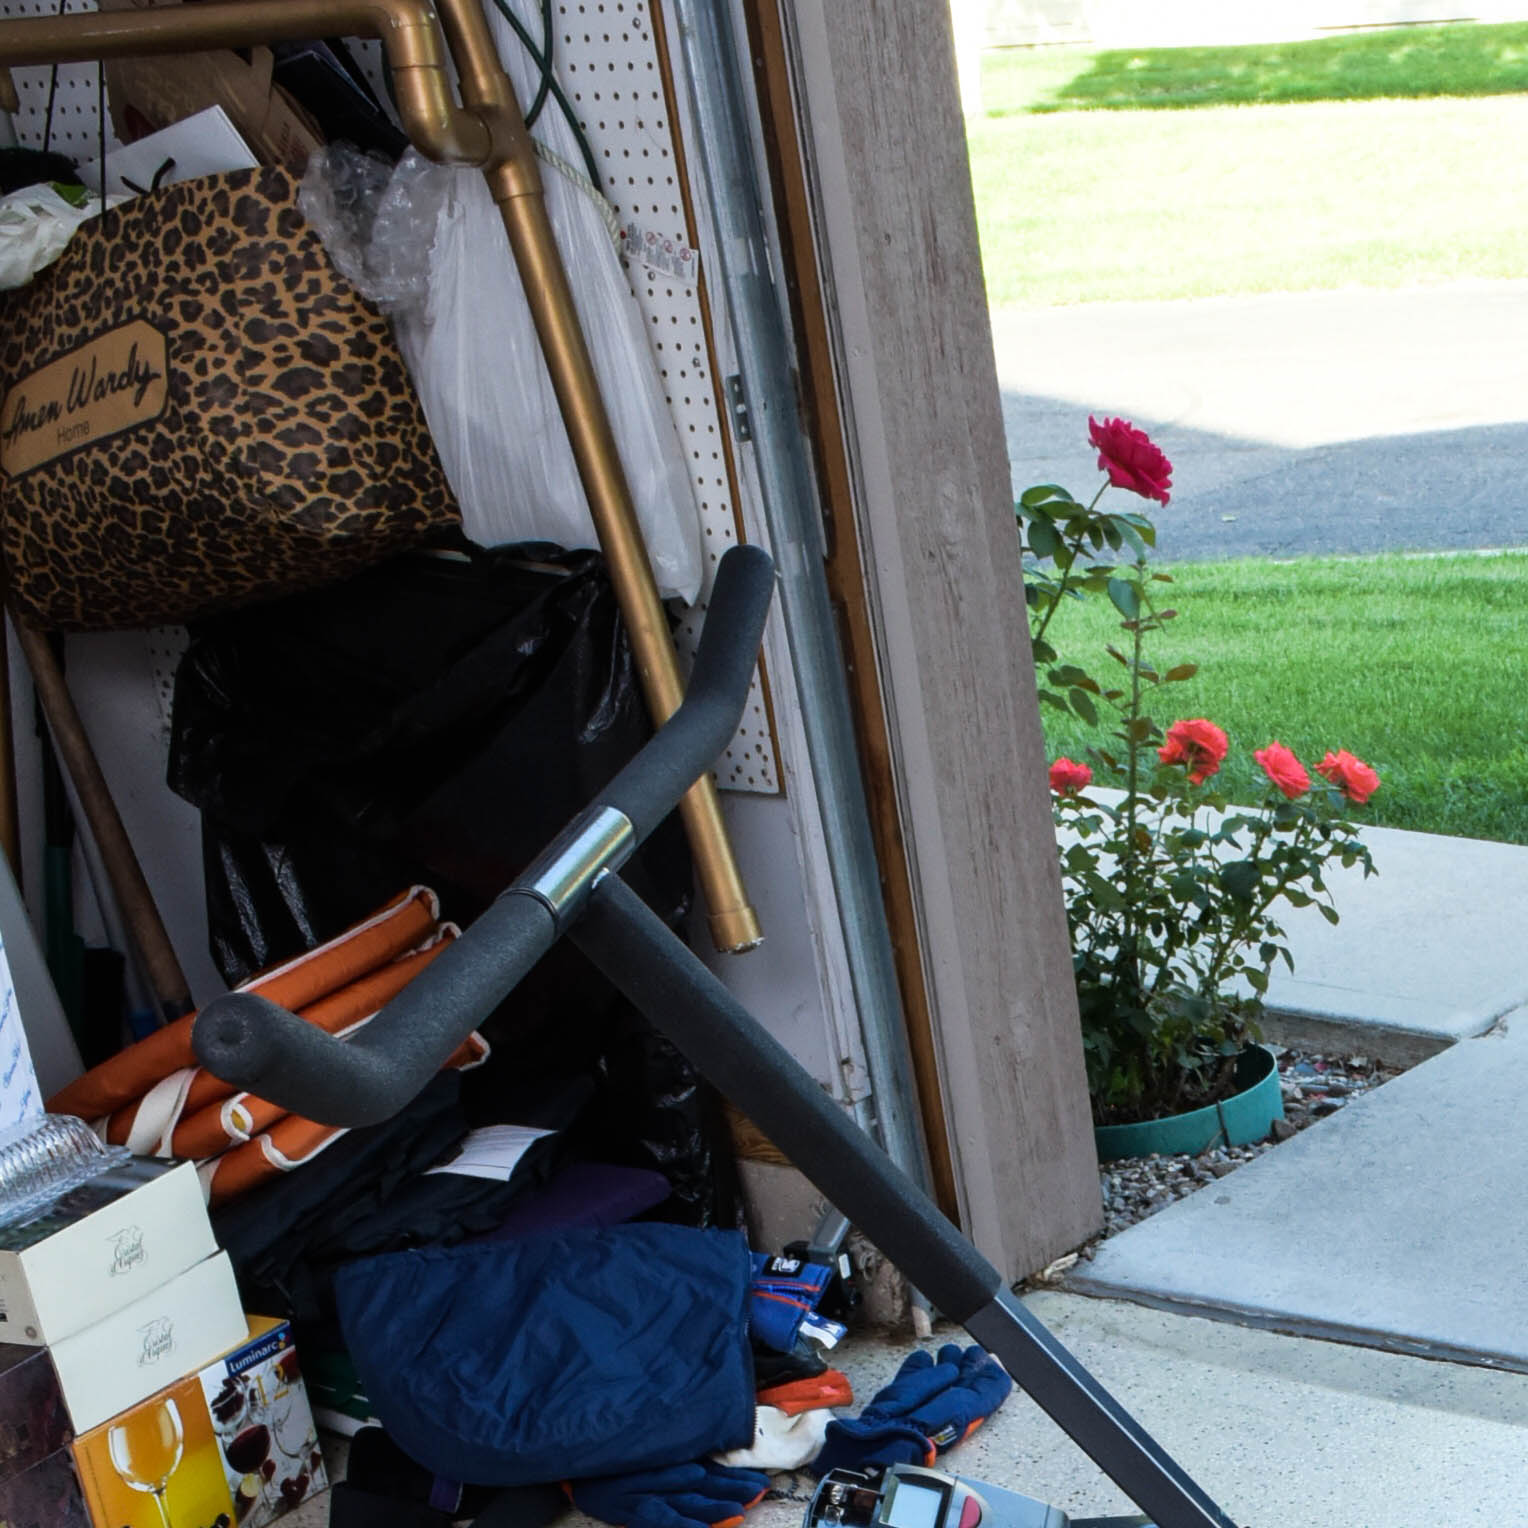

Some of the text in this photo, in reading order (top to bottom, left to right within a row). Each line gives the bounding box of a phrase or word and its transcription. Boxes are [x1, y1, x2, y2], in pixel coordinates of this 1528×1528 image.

[66, 341, 161, 414] Wardy
[56, 421, 90, 445] Home
[229, 1340, 278, 1373] Luminarc
